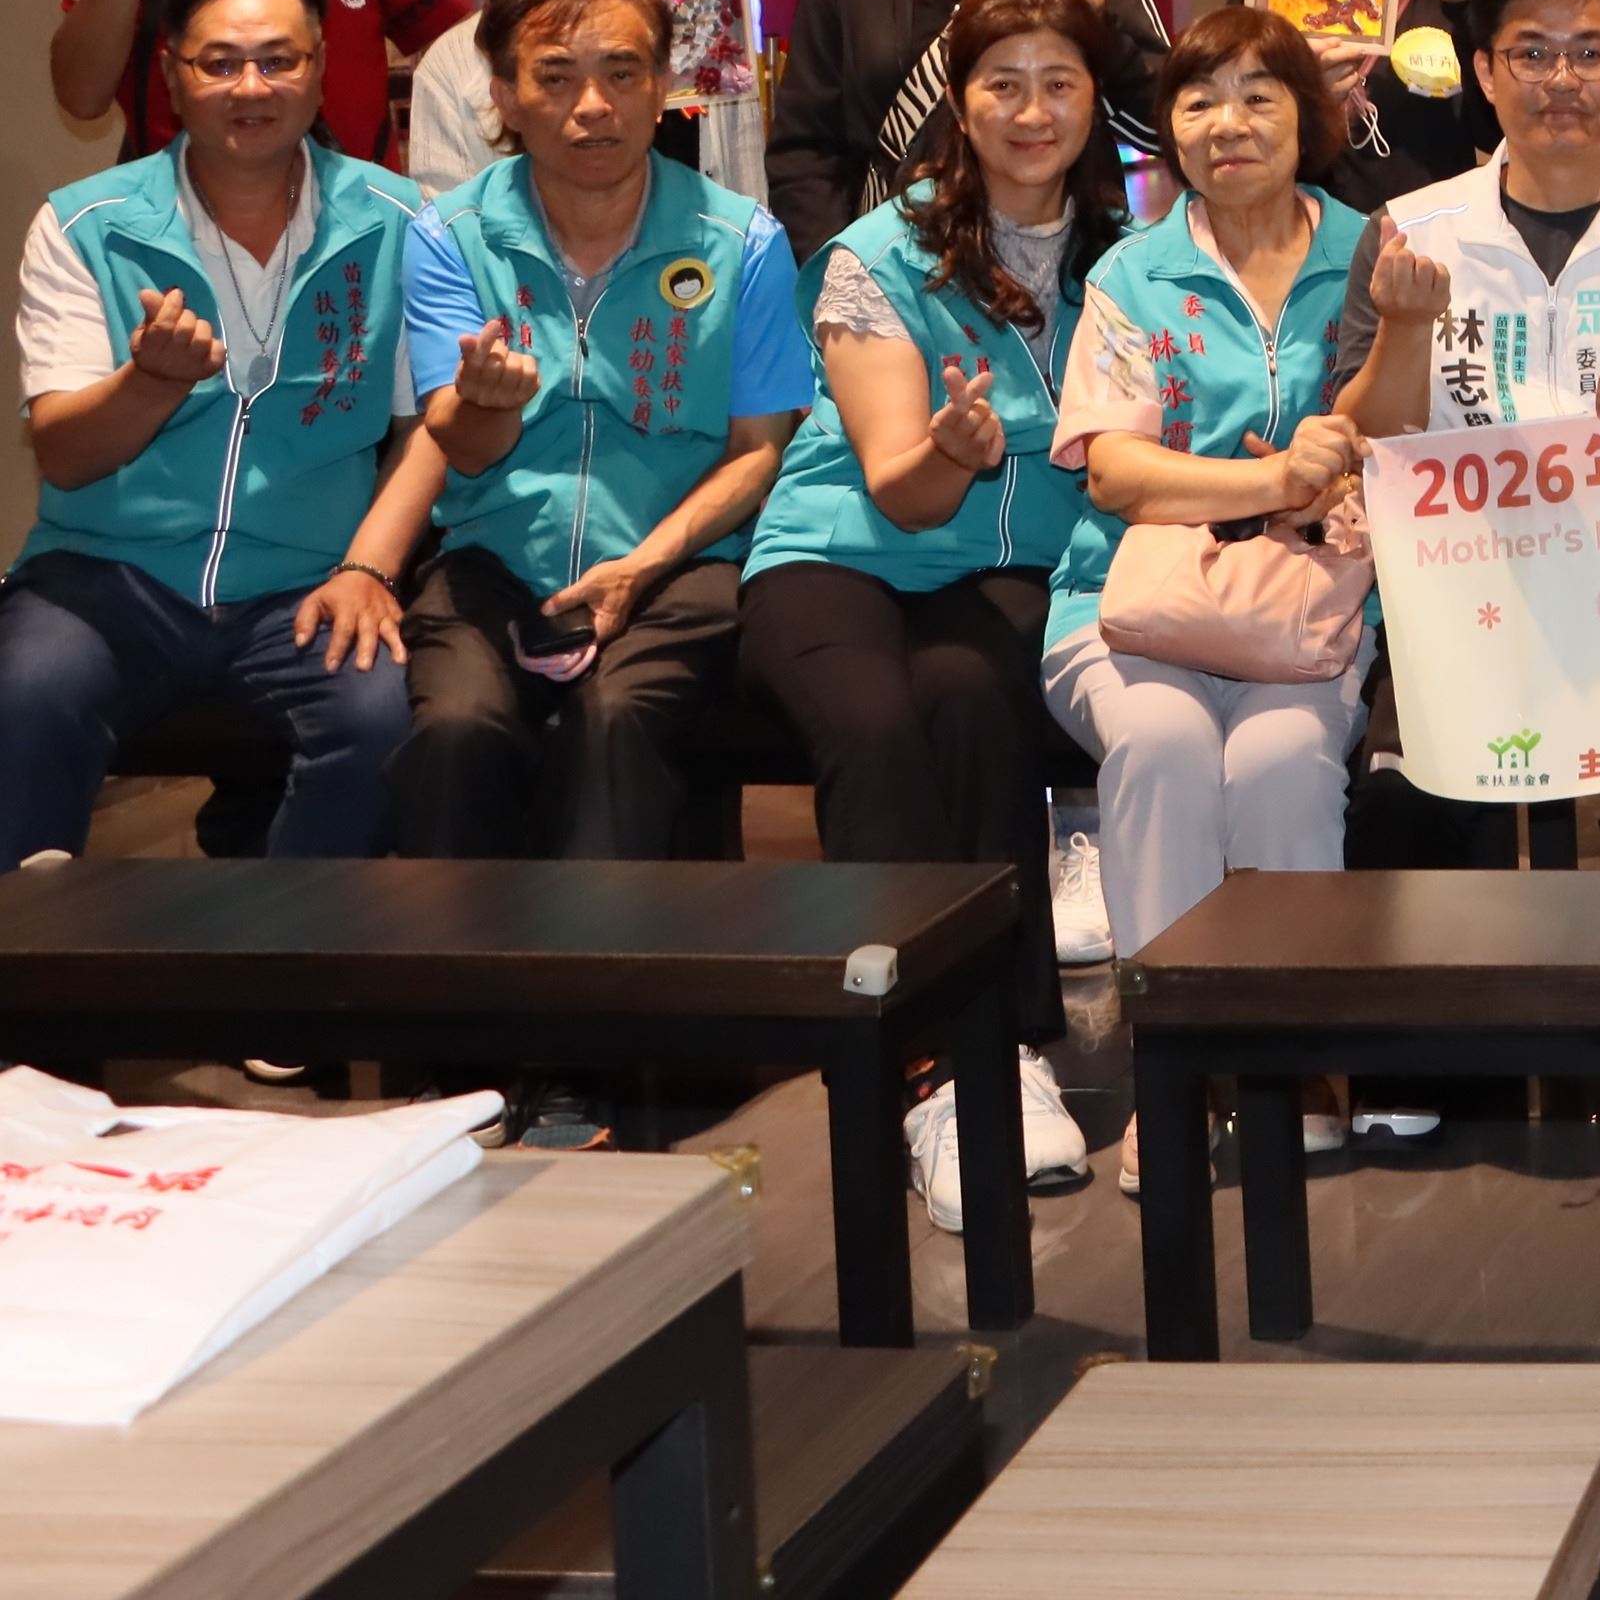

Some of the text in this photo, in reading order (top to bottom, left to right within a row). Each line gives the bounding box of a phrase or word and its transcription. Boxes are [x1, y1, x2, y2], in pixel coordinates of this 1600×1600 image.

[1182, 294, 1206, 356] 委員
[629, 317, 656, 436] 扶幼委員
[659, 304, 688, 433] 栗家扶中
[1576, 347, 1597, 396] 委員
[1416, 520, 1583, 568] Mother's
[1476, 772, 1551, 788] 家扶基金會
